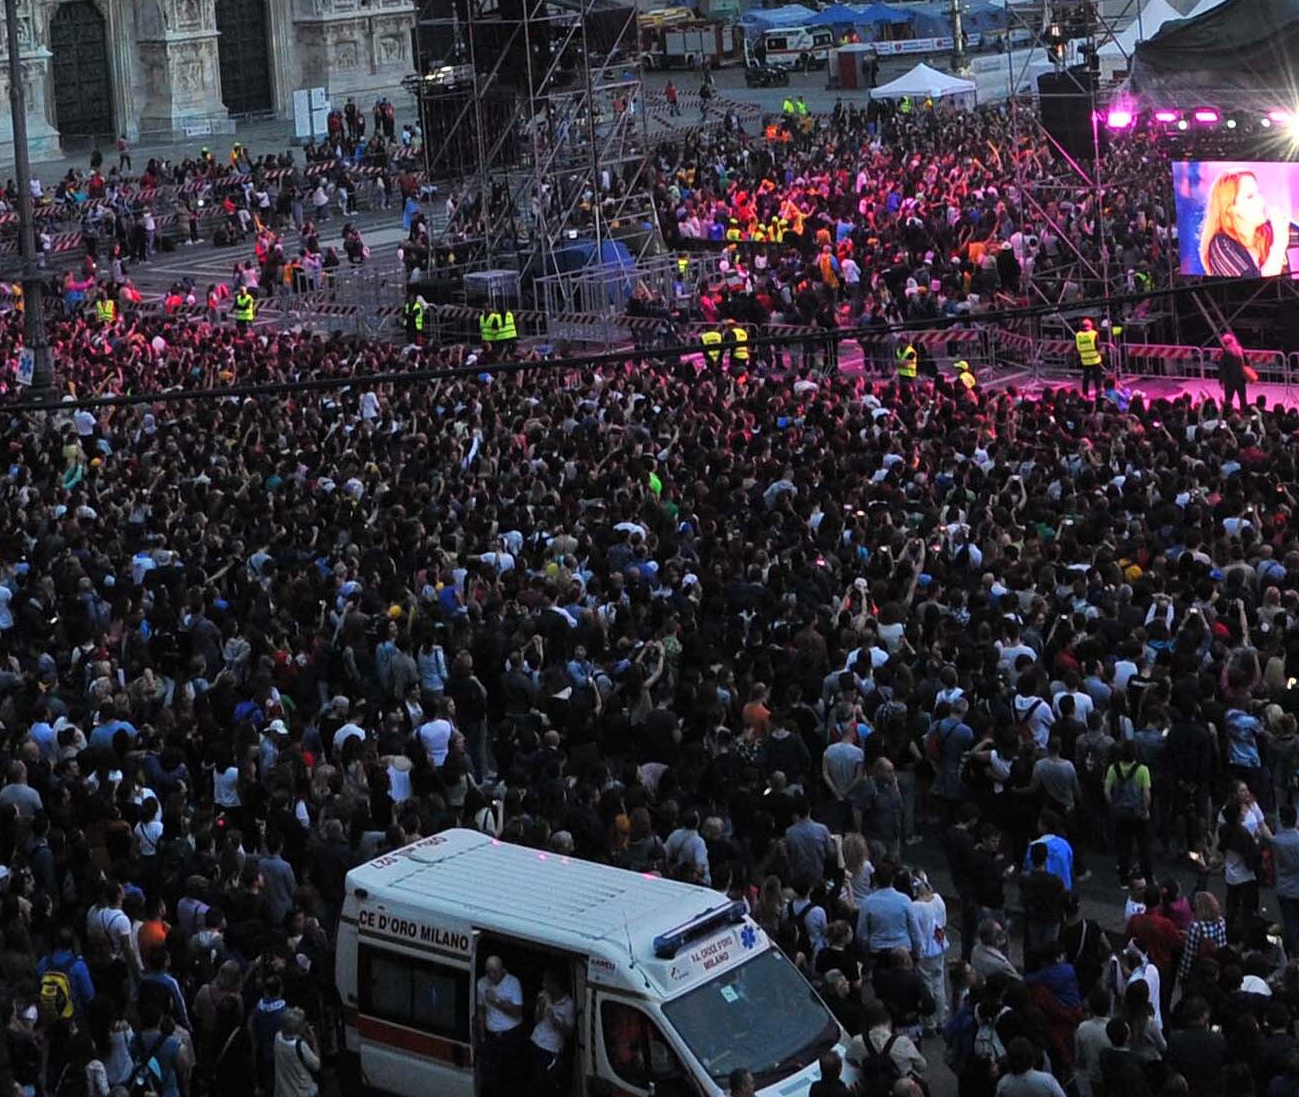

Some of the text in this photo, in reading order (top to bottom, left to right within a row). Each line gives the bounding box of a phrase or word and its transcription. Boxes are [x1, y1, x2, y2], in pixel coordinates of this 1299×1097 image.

[378, 915, 417, 938] D'ORO
[420, 925, 469, 951] MILANO
[703, 952, 730, 971] MILANO
